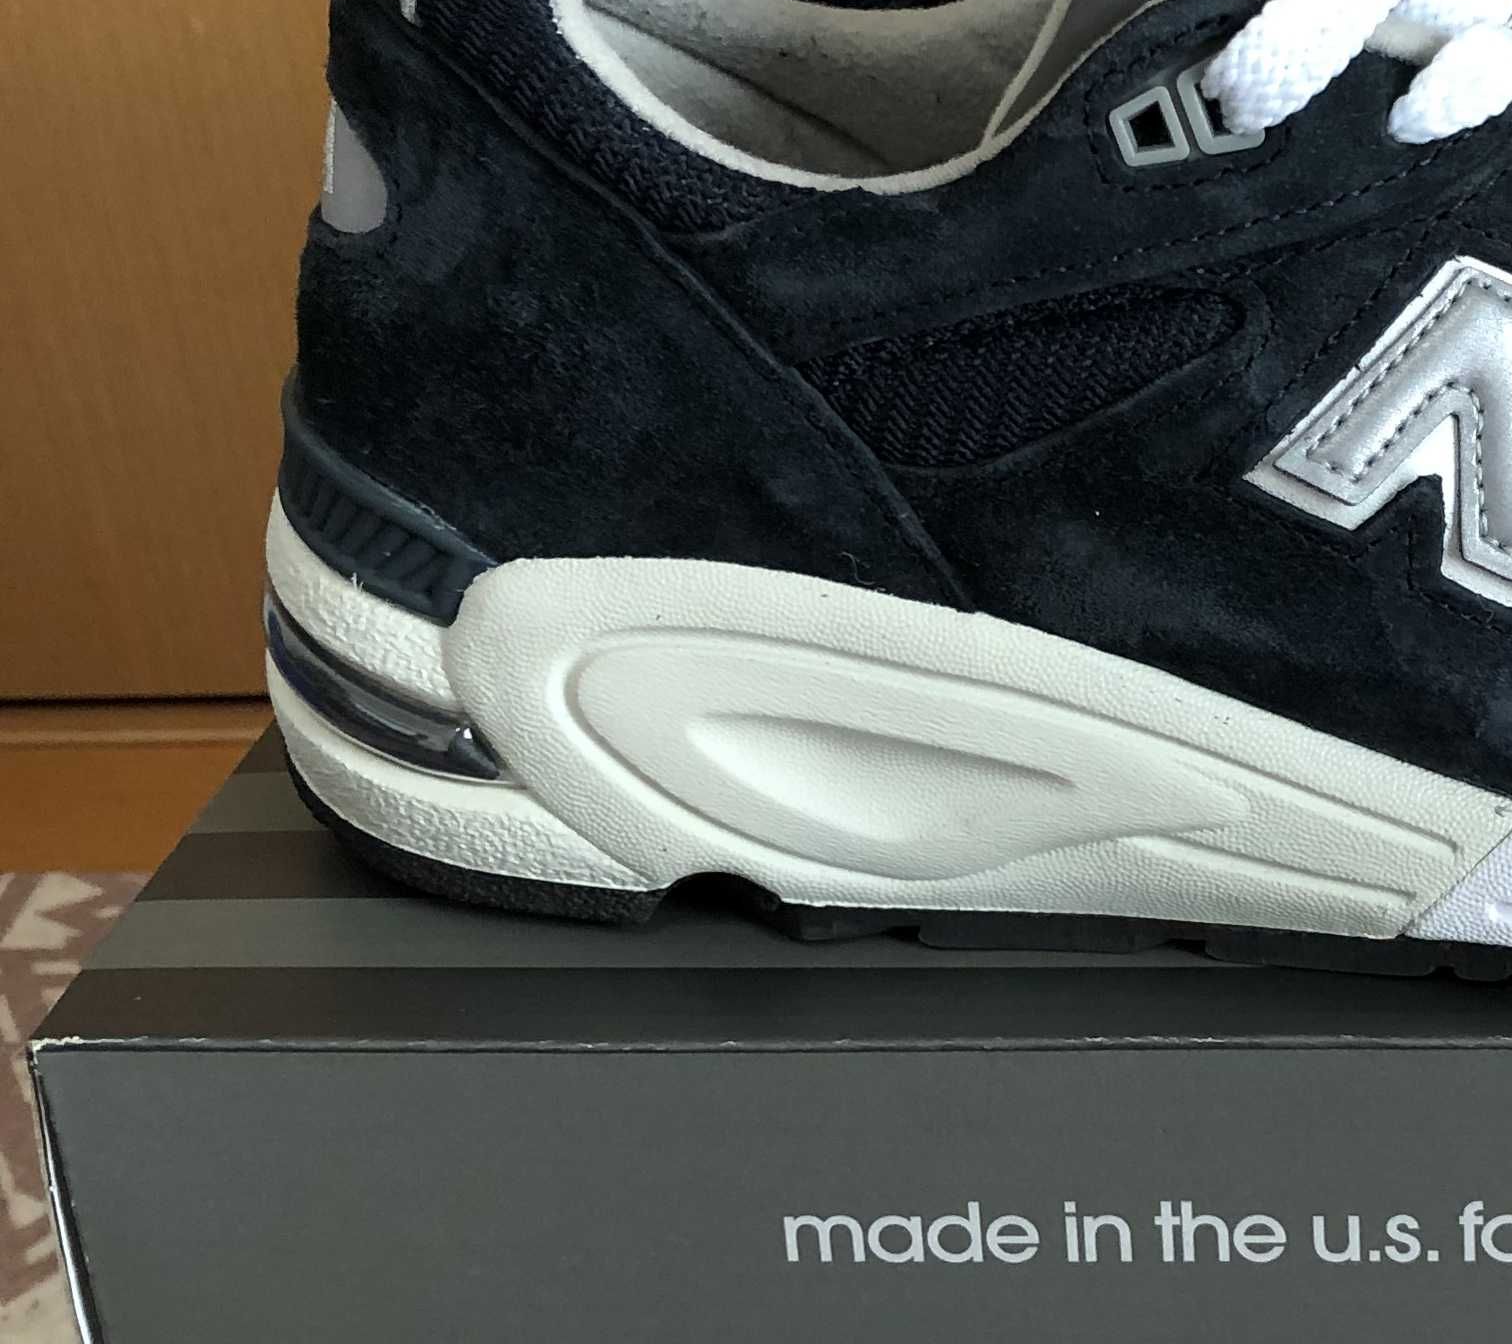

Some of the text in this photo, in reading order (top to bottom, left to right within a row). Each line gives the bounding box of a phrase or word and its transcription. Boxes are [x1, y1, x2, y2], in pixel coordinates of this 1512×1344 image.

[782, 1200, 1040, 1264] made
[1064, 1201, 1133, 1263] in
[1154, 1200, 1287, 1263] the
[1312, 1214, 1439, 1263] u.s.
